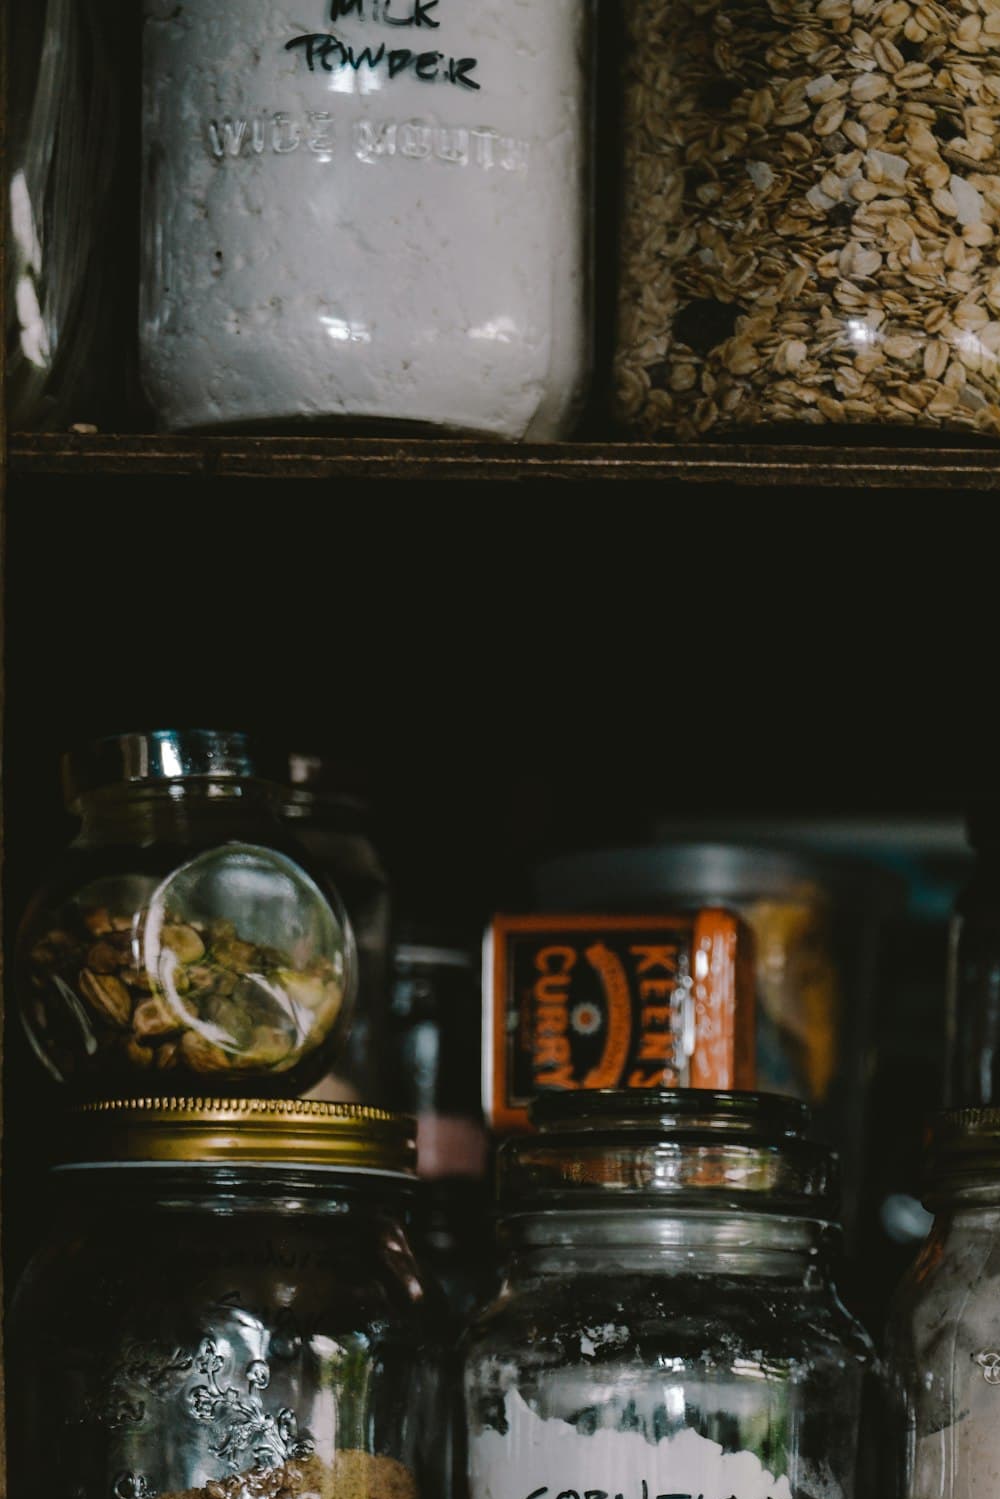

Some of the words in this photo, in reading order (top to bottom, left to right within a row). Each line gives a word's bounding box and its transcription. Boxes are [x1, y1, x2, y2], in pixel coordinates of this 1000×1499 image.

[329, 0, 440, 28] MILK
[284, 33, 480, 90] POWDER
[207, 110, 334, 158] WIDE
[532, 943, 583, 1090] CURRY
